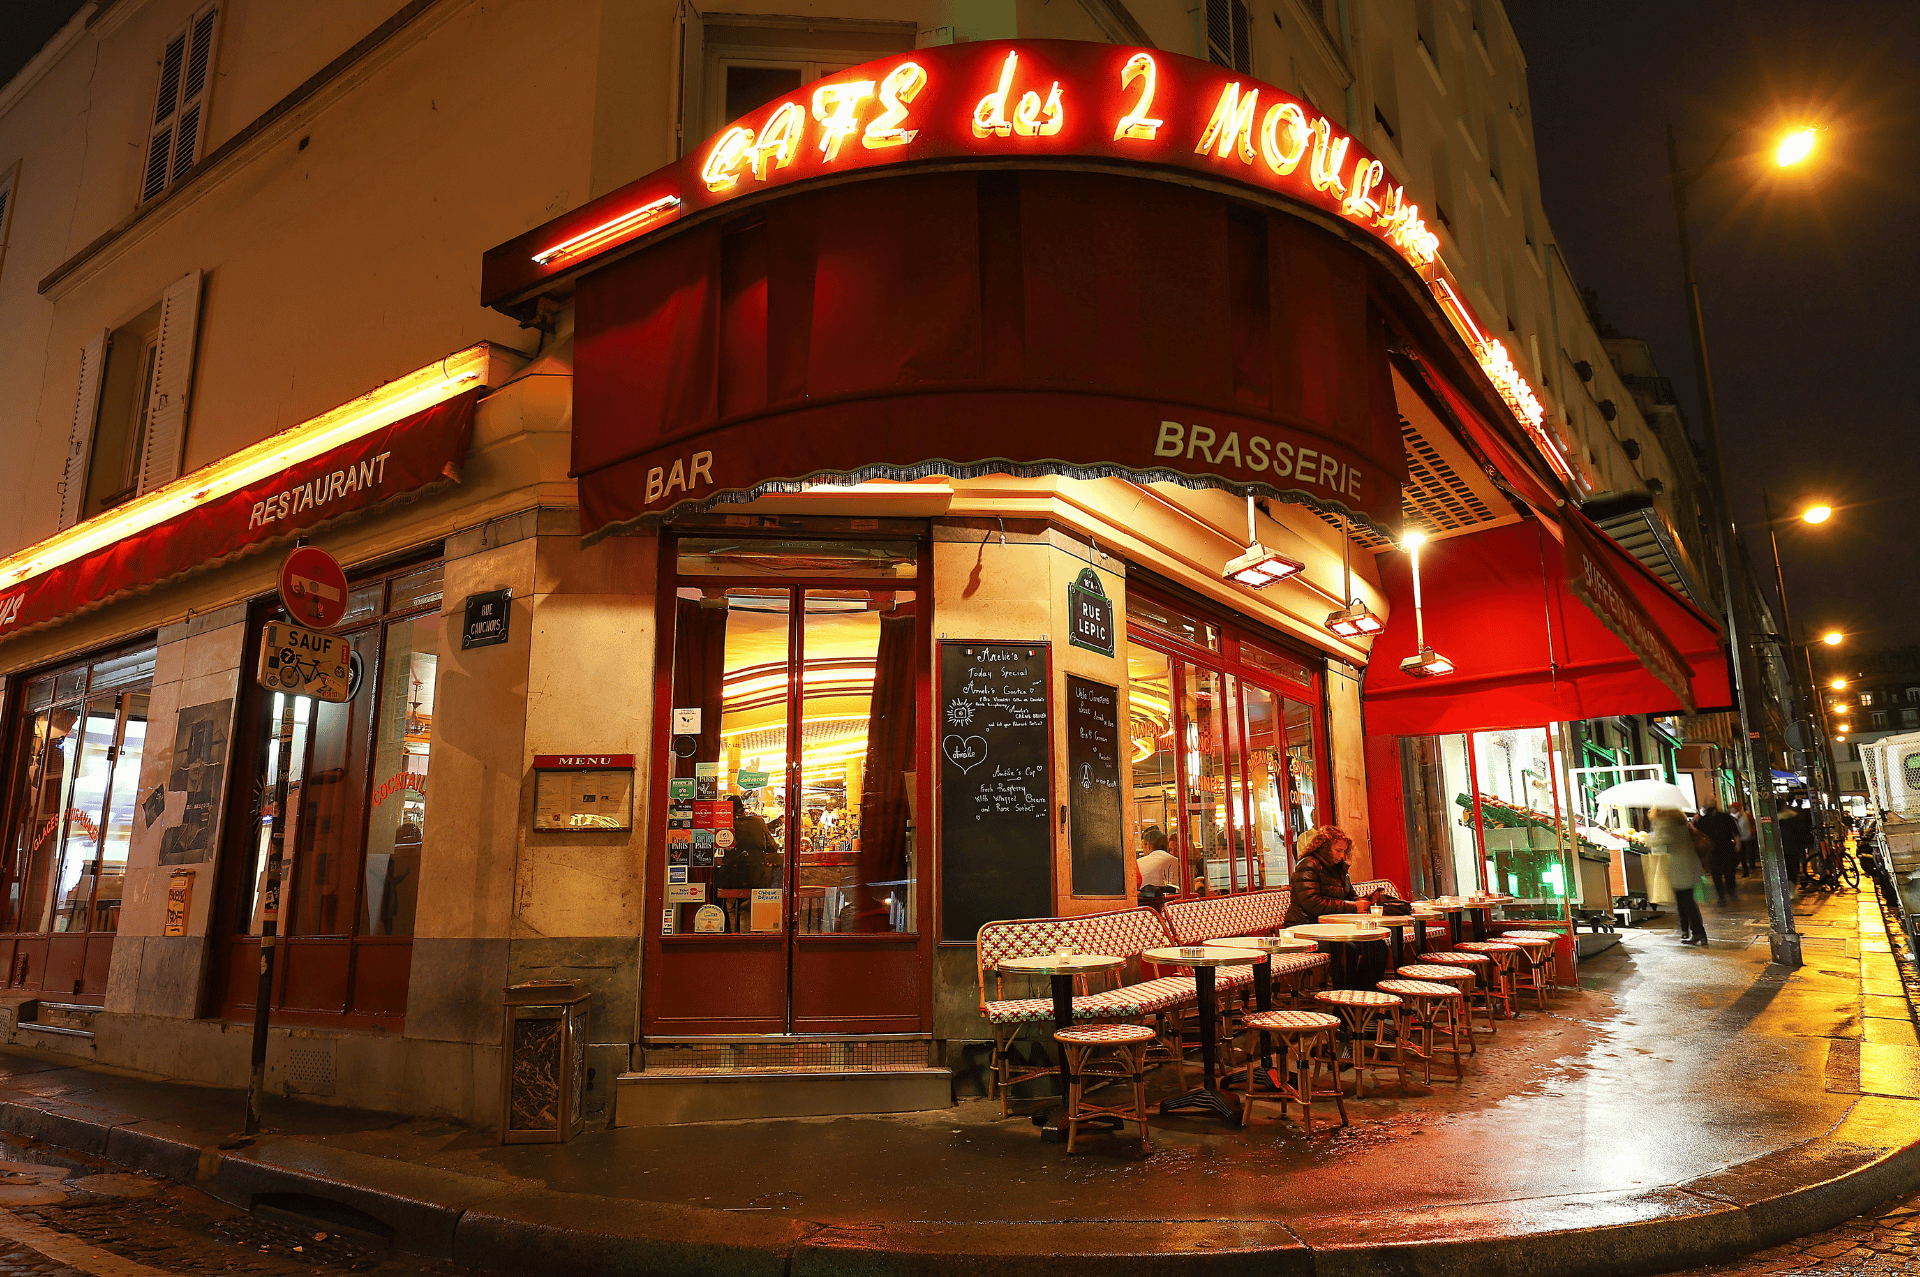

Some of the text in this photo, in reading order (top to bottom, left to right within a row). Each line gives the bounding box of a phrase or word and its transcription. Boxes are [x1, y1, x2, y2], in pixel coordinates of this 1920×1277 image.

[702, 62, 928, 192] CAFE
[972, 50, 1064, 139] des
[1113, 52, 1164, 141] 2
[1154, 420, 1362, 502] BRASSERIE
[644, 450, 713, 504] BAR
[248, 451, 391, 530] RESTAURANT
[482, 603, 494, 617] RUE
[1082, 602, 1101, 621] RUE
[470, 618, 501, 635] CAUCHOIS
[1078, 618, 1106, 640] LEPIC
[288, 630, 332, 654] SAUF
[967, 666, 1028, 679] Today Special
[558, 757, 612, 765] MENU
[373, 771, 426, 807] COCKTAIL
[33, 812, 60, 852] GLACES
